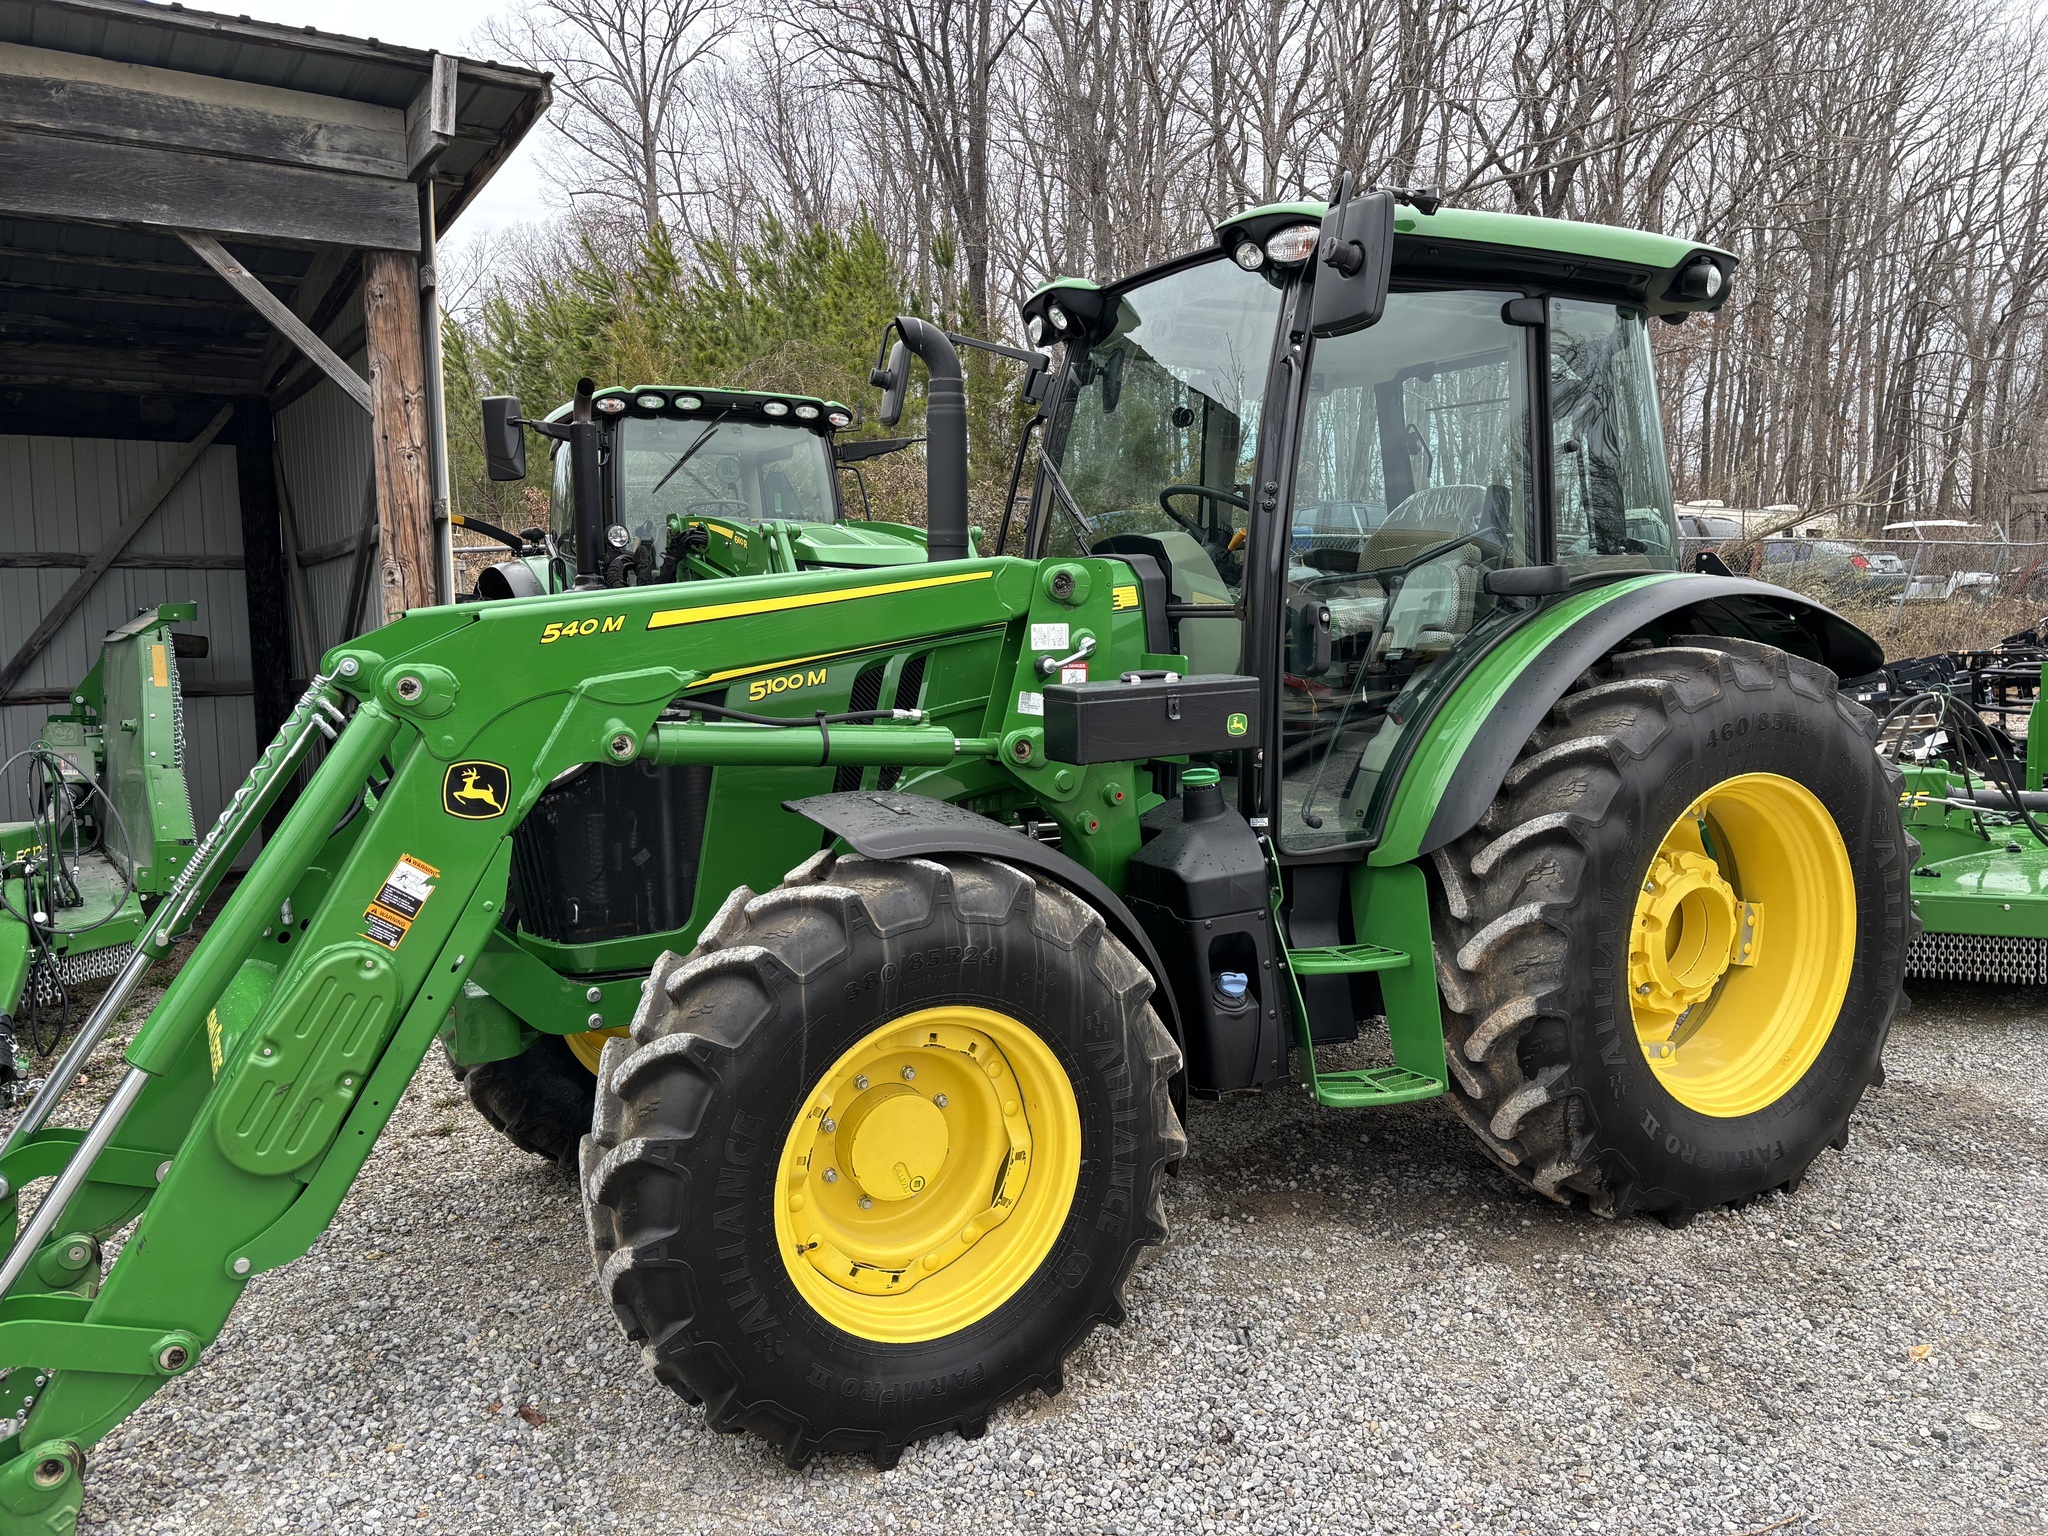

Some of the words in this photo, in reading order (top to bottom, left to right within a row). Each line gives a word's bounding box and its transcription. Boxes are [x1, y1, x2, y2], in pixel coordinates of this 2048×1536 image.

[540, 617, 599, 644] 540
[749, 673, 804, 702] 5100
[379, 910, 406, 928] WARNING
[844, 945, 998, 1001] 380/85R24
[1084, 1036, 1139, 1238] ALLIANCE
[712, 1109, 781, 1335] ALLIANCE
[840, 1361, 987, 1403] FARMPRO
